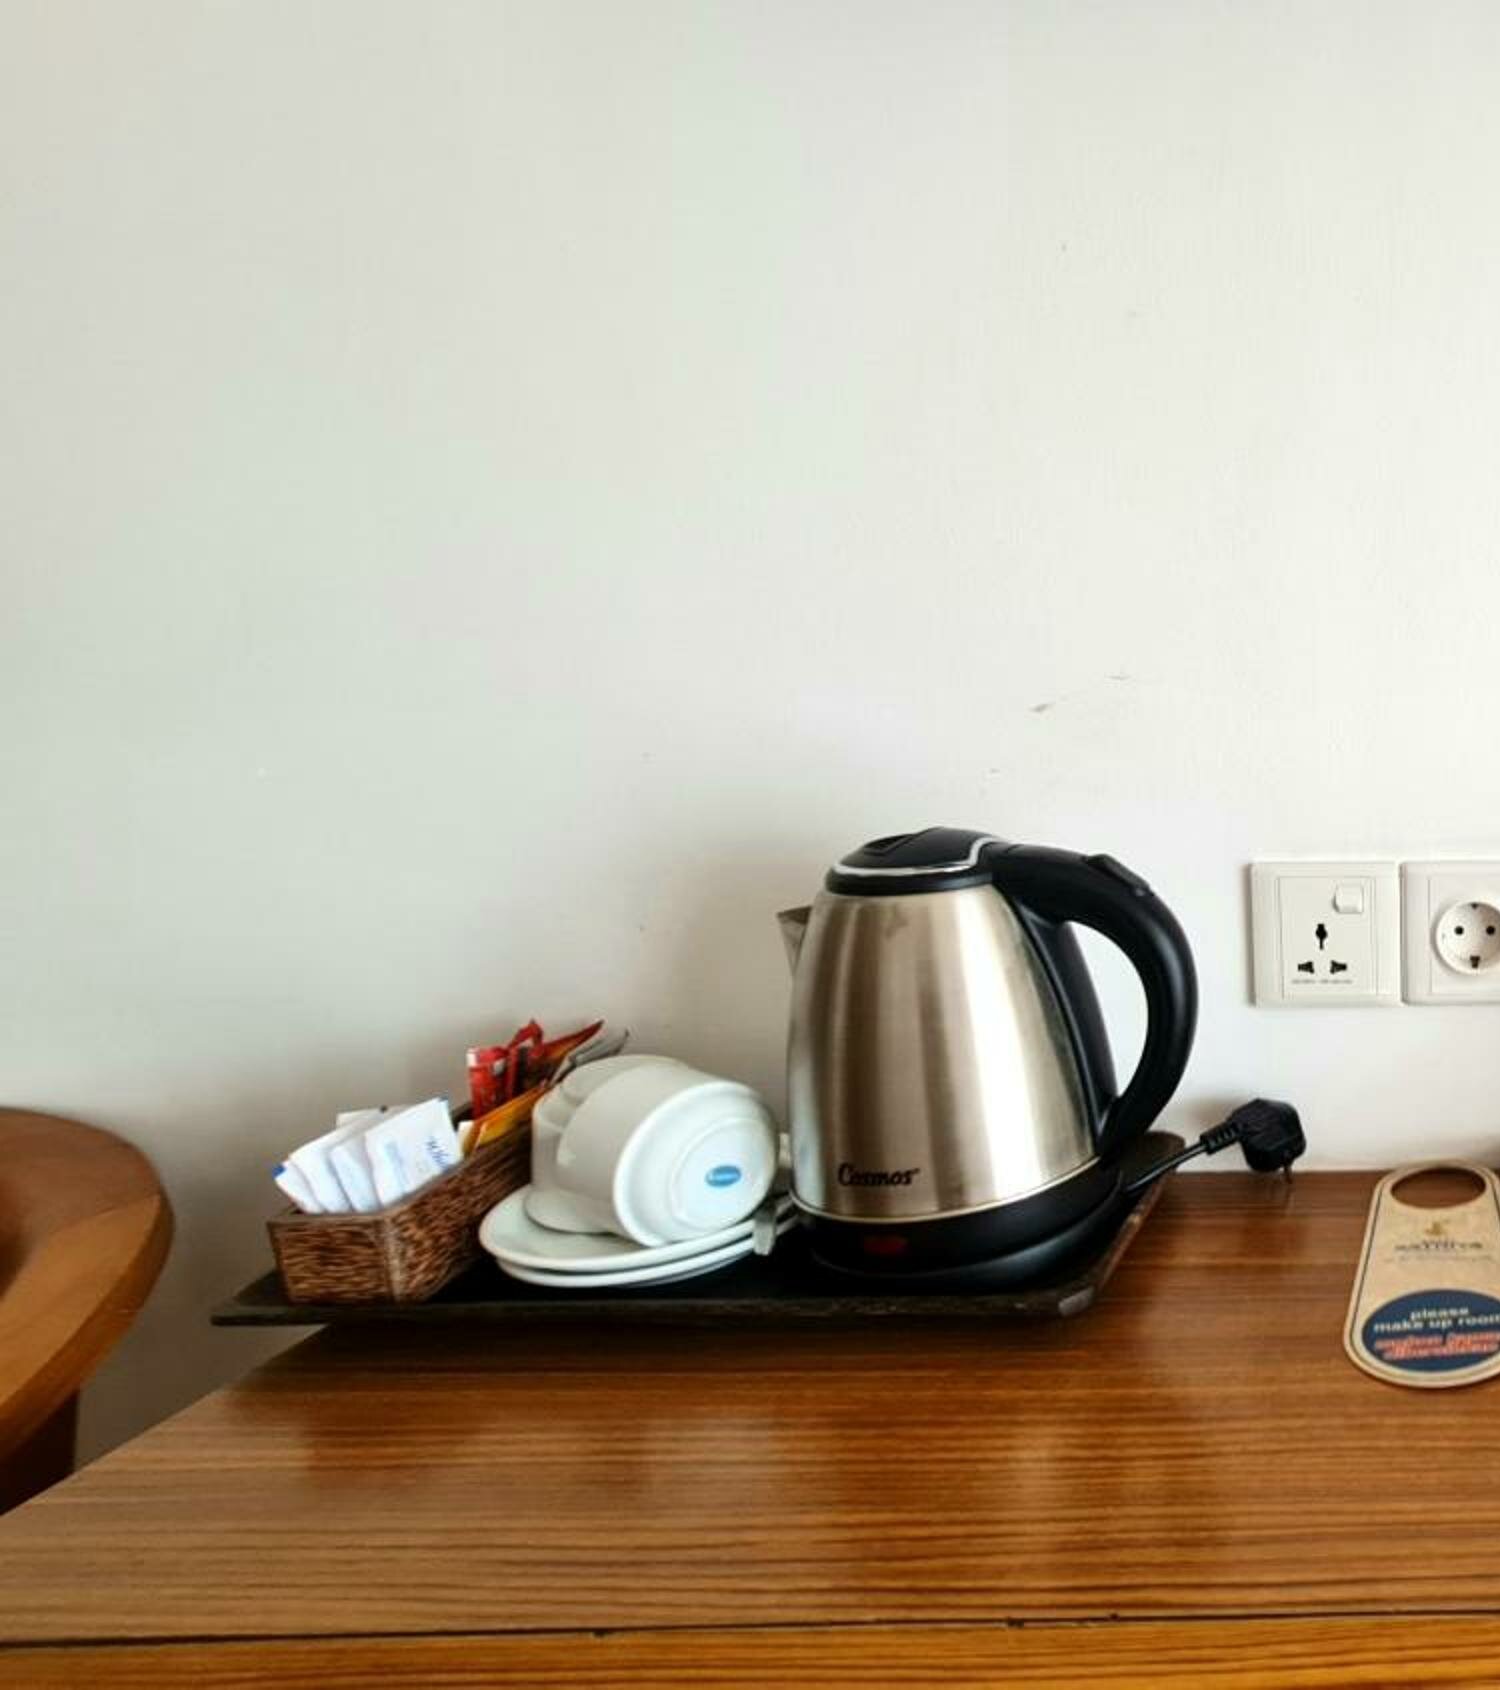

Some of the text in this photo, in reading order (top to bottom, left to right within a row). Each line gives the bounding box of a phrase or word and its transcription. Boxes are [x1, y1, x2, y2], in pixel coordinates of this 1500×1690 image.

[838, 1162, 914, 1186] Cosmos
[1410, 1307, 1469, 1321] please
[1373, 1319, 1424, 1333] make
[1428, 1319, 1453, 1329] up
